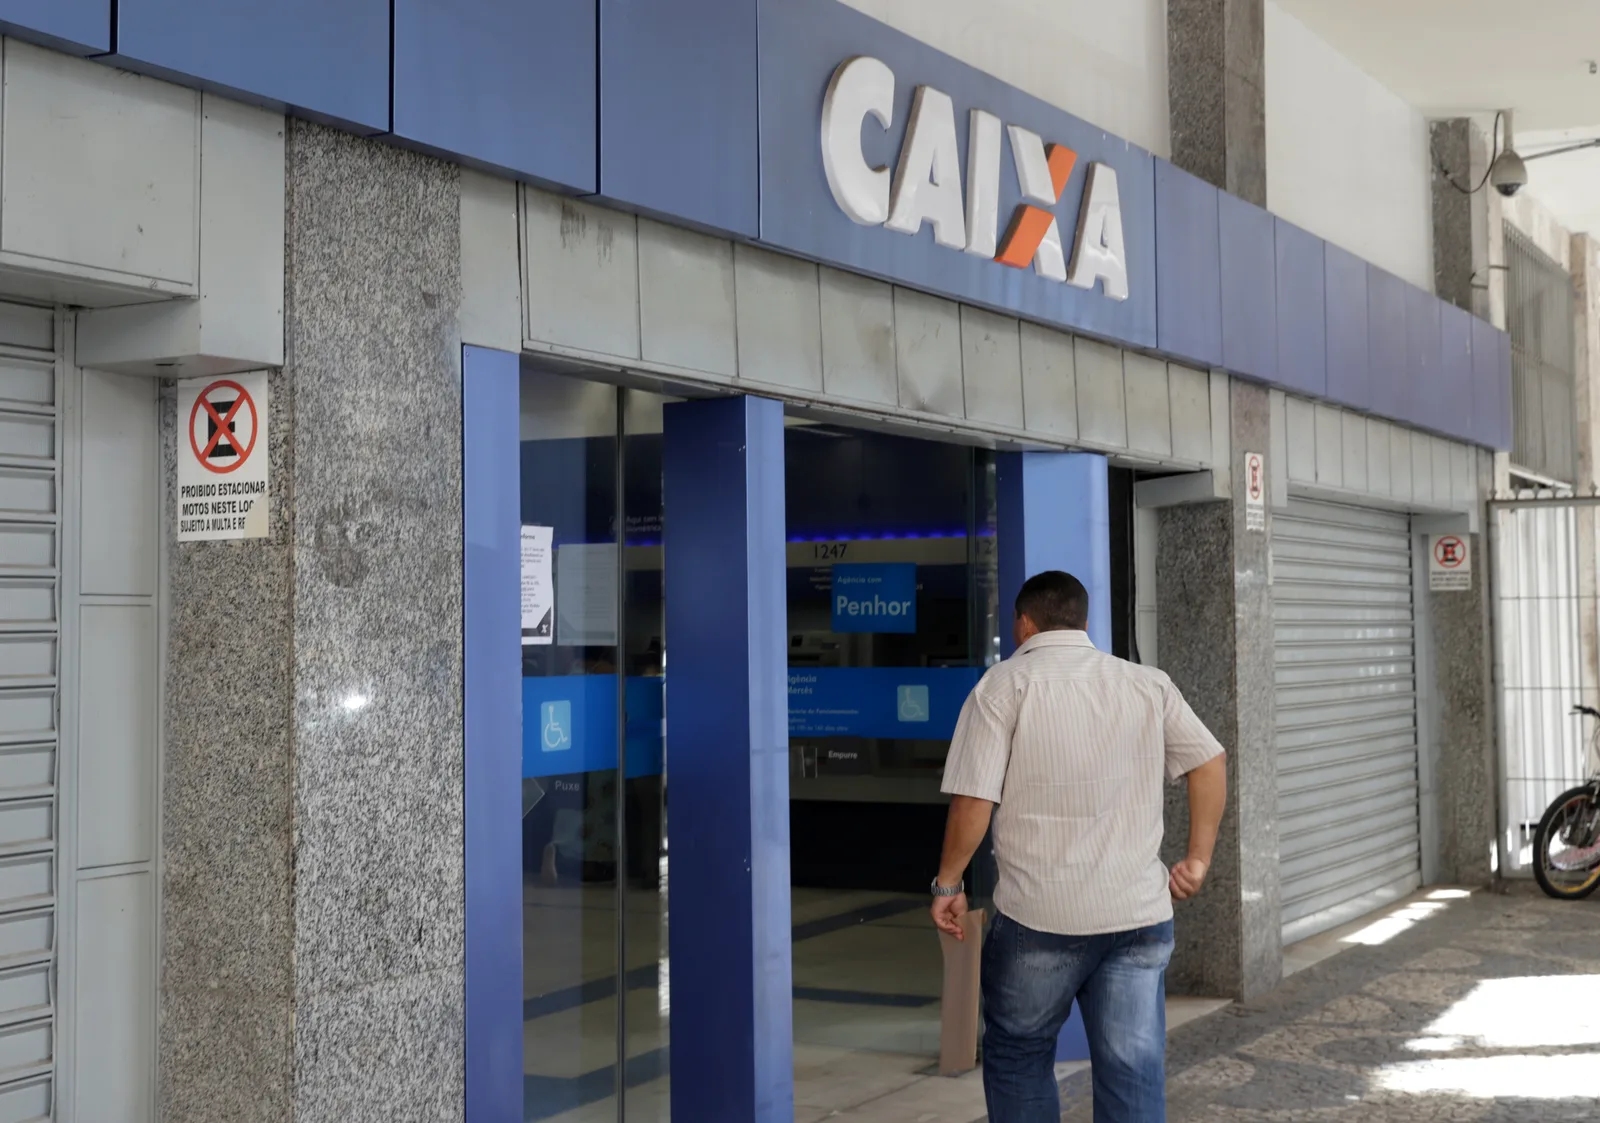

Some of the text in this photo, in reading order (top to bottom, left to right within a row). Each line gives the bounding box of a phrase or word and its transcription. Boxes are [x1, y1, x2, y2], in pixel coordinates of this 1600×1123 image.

[821, 55, 1128, 302] CAIXA
[181, 481, 266, 498] PROIBIDO ESTACIONAR
[182, 502, 209, 516] MOTOS
[211, 501, 237, 515] NESTE
[180, 518, 205, 532] SUJEITO
[206, 518, 211, 531] A
[212, 517, 232, 531] MULTA
[233, 517, 237, 530] E
[814, 543, 848, 560] 1247
[837, 575, 866, 584] Agência
[836, 594, 912, 616] Penhor
[828, 750, 858, 760] Empurre
[555, 780, 580, 791] Puxe
